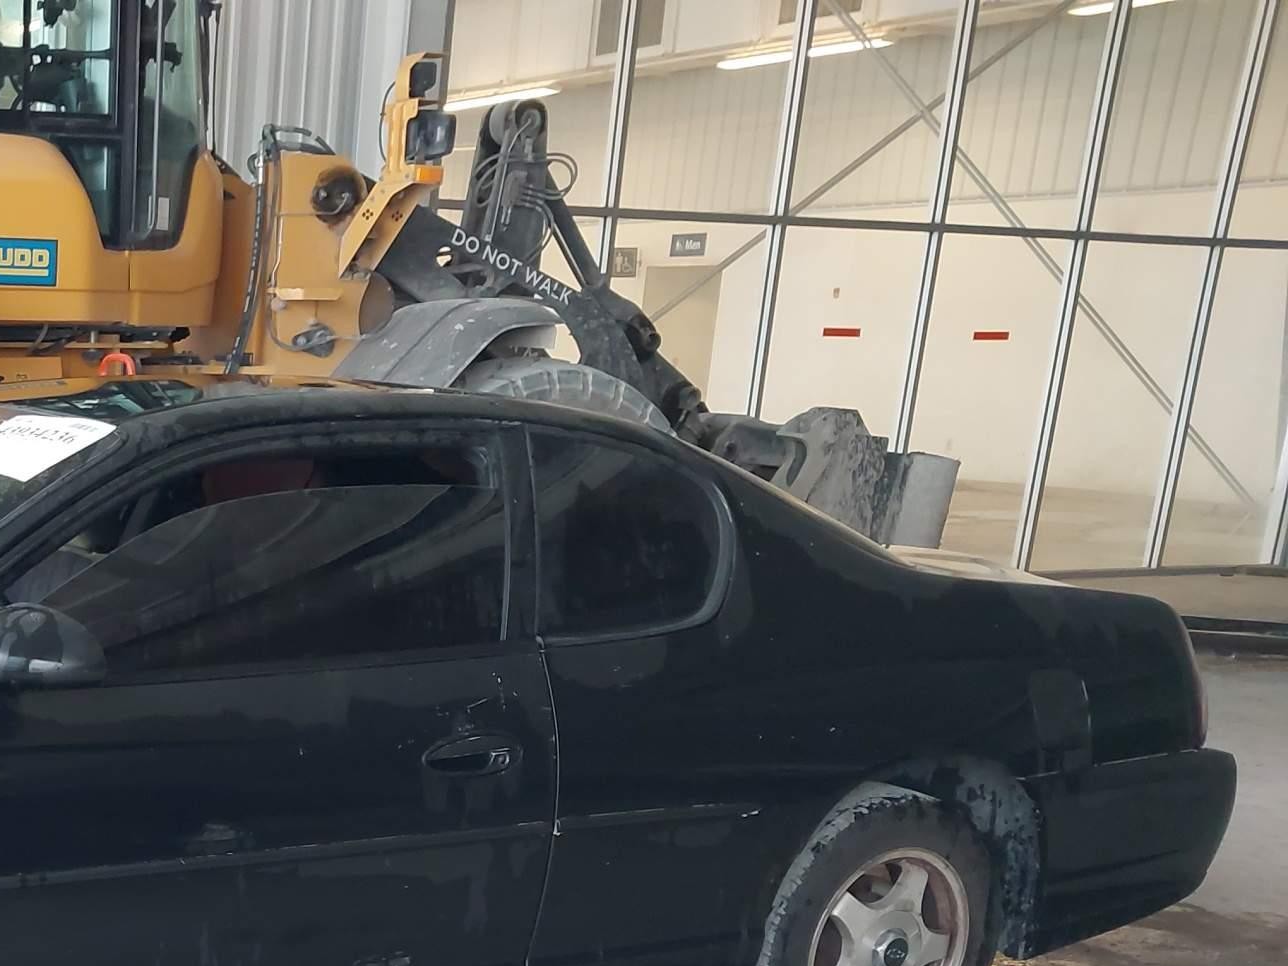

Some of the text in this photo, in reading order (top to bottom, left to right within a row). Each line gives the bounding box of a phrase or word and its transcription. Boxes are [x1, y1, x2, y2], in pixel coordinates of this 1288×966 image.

[452, 228, 572, 305] DO NOT WALK
